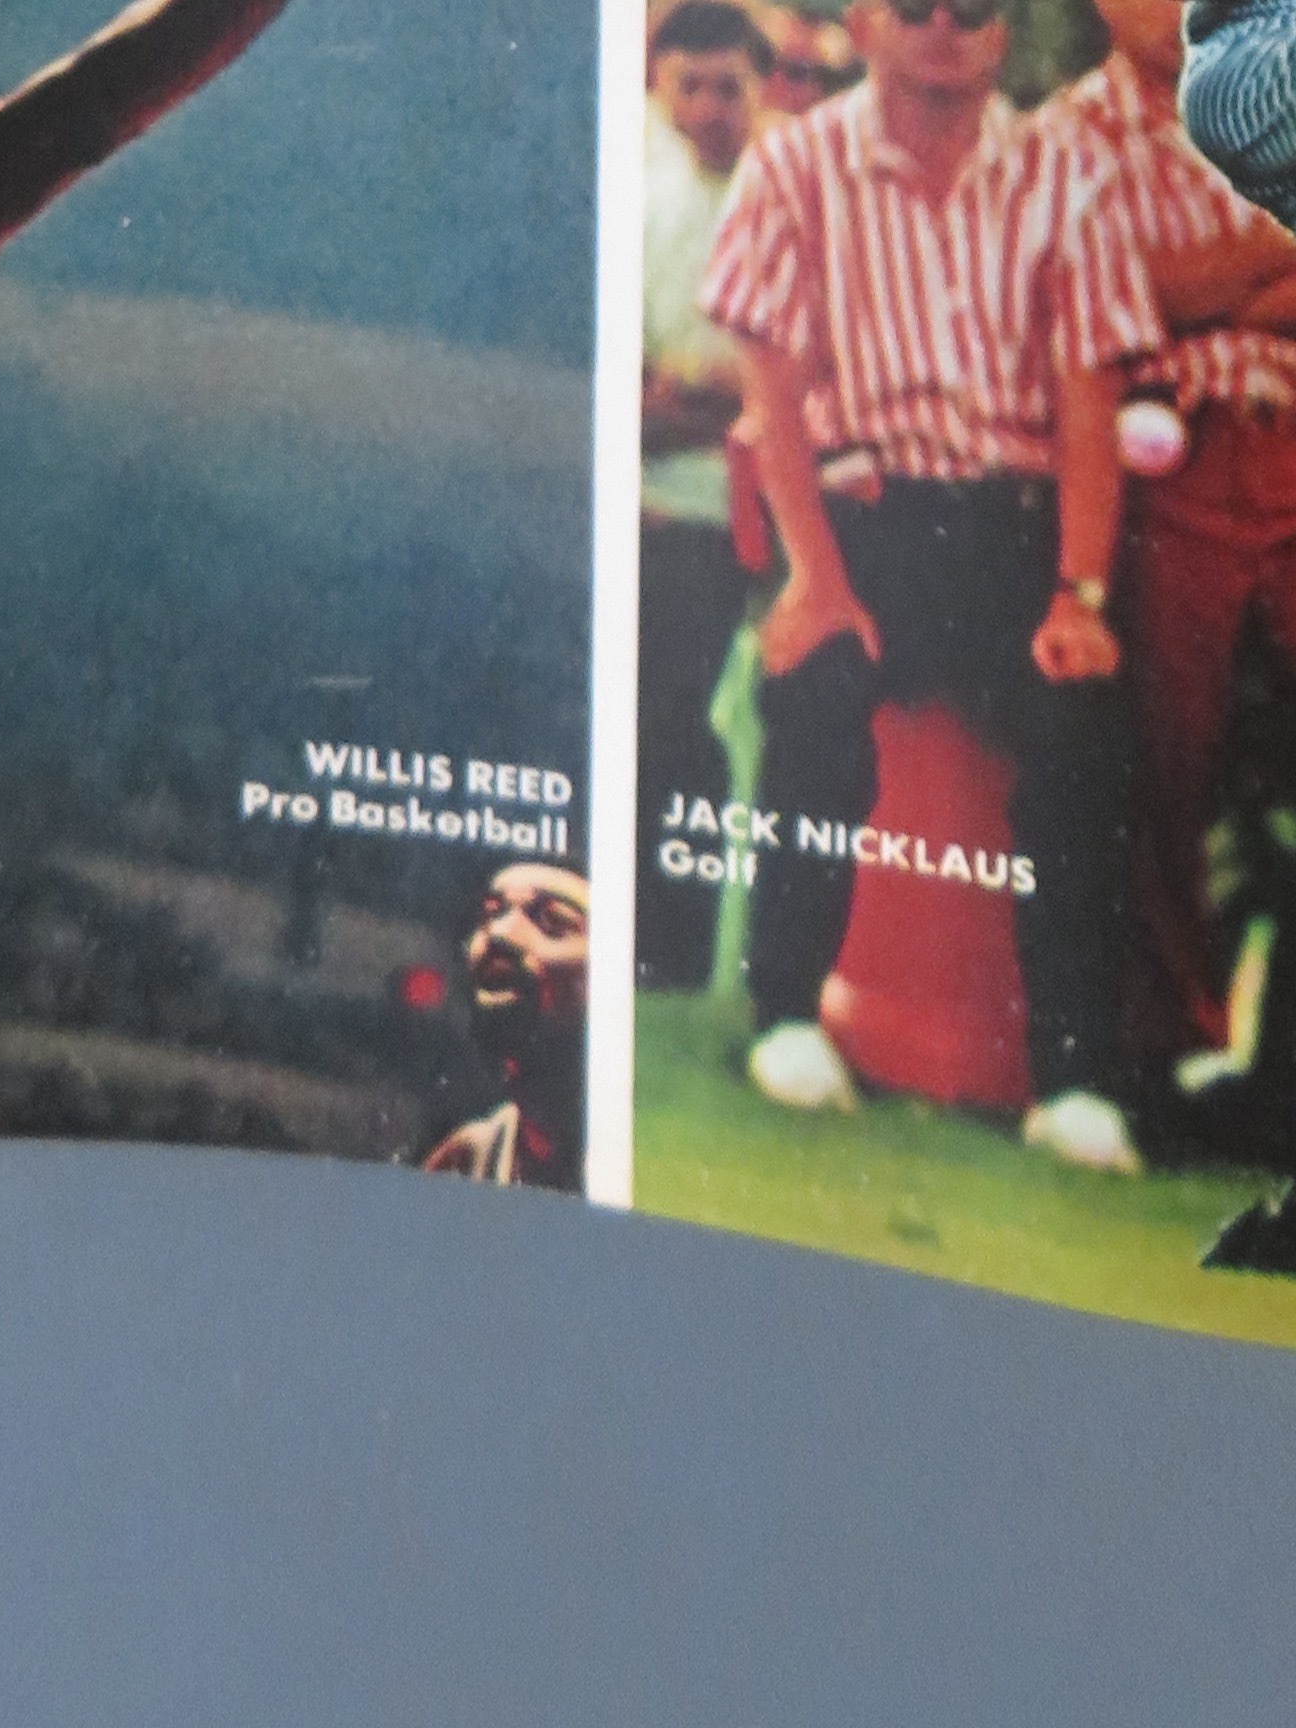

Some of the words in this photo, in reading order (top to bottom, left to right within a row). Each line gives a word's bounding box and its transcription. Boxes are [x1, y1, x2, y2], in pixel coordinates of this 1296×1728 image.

[305, 741, 453, 793] WILLIS
[467, 760, 573, 806] REED
[241, 781, 319, 823] Pro
[329, 791, 568, 855] Basketball
[663, 793, 780, 845] JACK
[798, 816, 1037, 895] NICKLAUS
[660, 839, 758, 887] Golf
